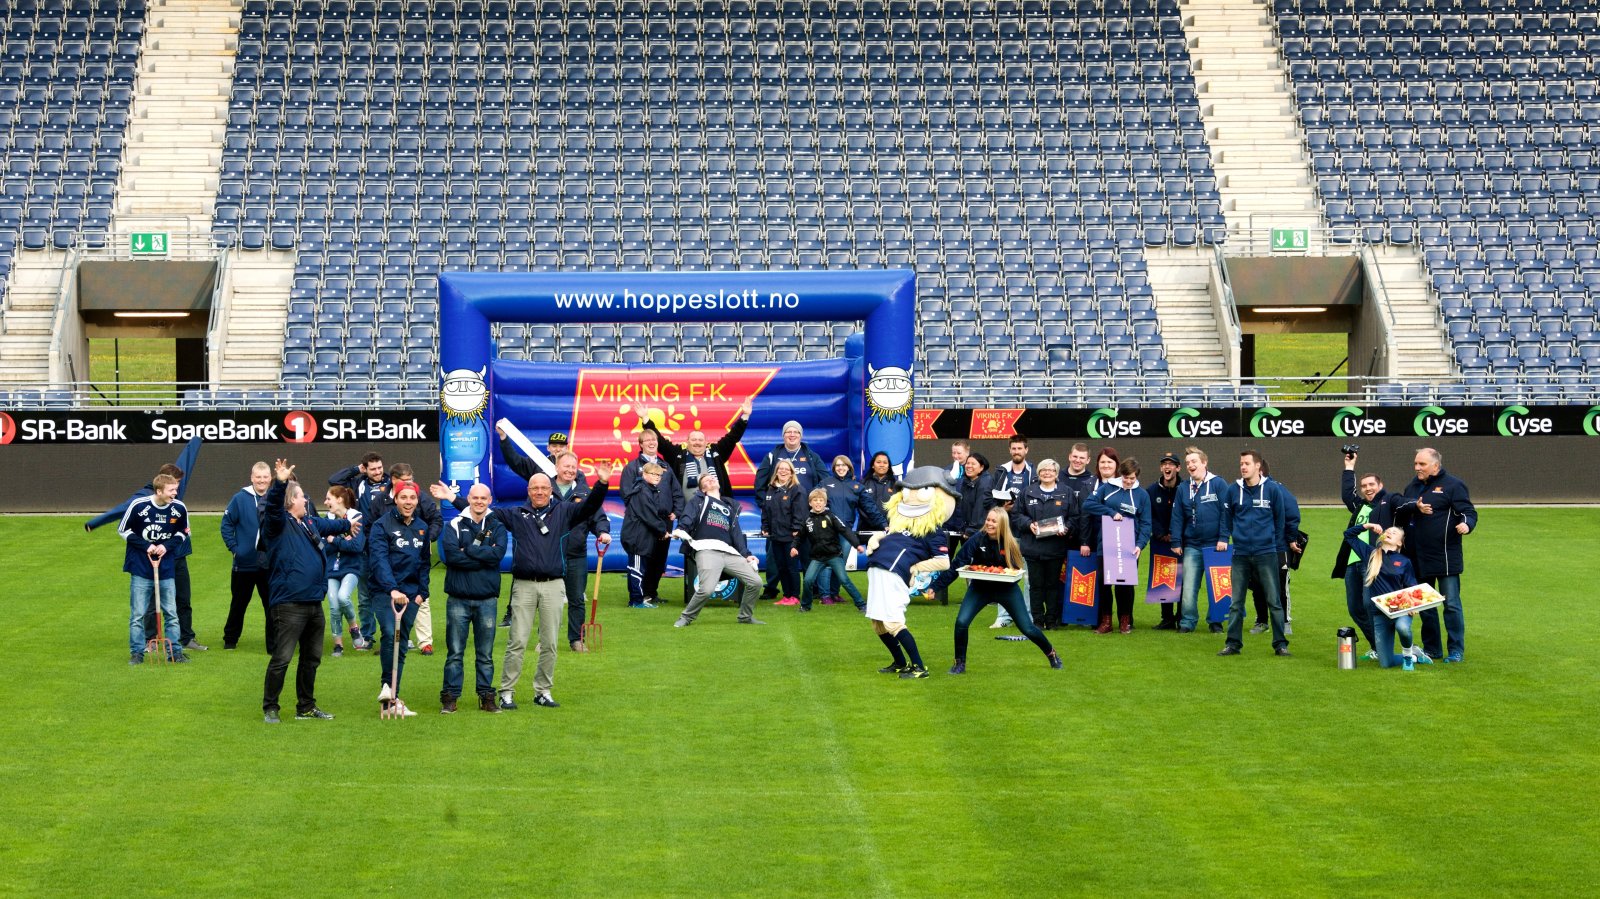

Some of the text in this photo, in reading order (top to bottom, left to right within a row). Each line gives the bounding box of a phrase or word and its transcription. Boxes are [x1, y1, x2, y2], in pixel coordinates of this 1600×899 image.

[554, 288, 799, 313] www.hoppeslott.no
[591, 384, 733, 402] VIKING F.K.
[21, 419, 127, 440] SR-Bank
[151, 417, 426, 443] SpareBank 1 SR-Bank
[1100, 418, 1141, 438] Lyse
[1181, 418, 1222, 438] Lyse
[1263, 417, 1305, 437] Lyse
[1344, 417, 1386, 437] Lyse
[1427, 417, 1469, 436] Lyse
[1510, 417, 1552, 436] Lyse
[151, 530, 172, 541] Lyse
